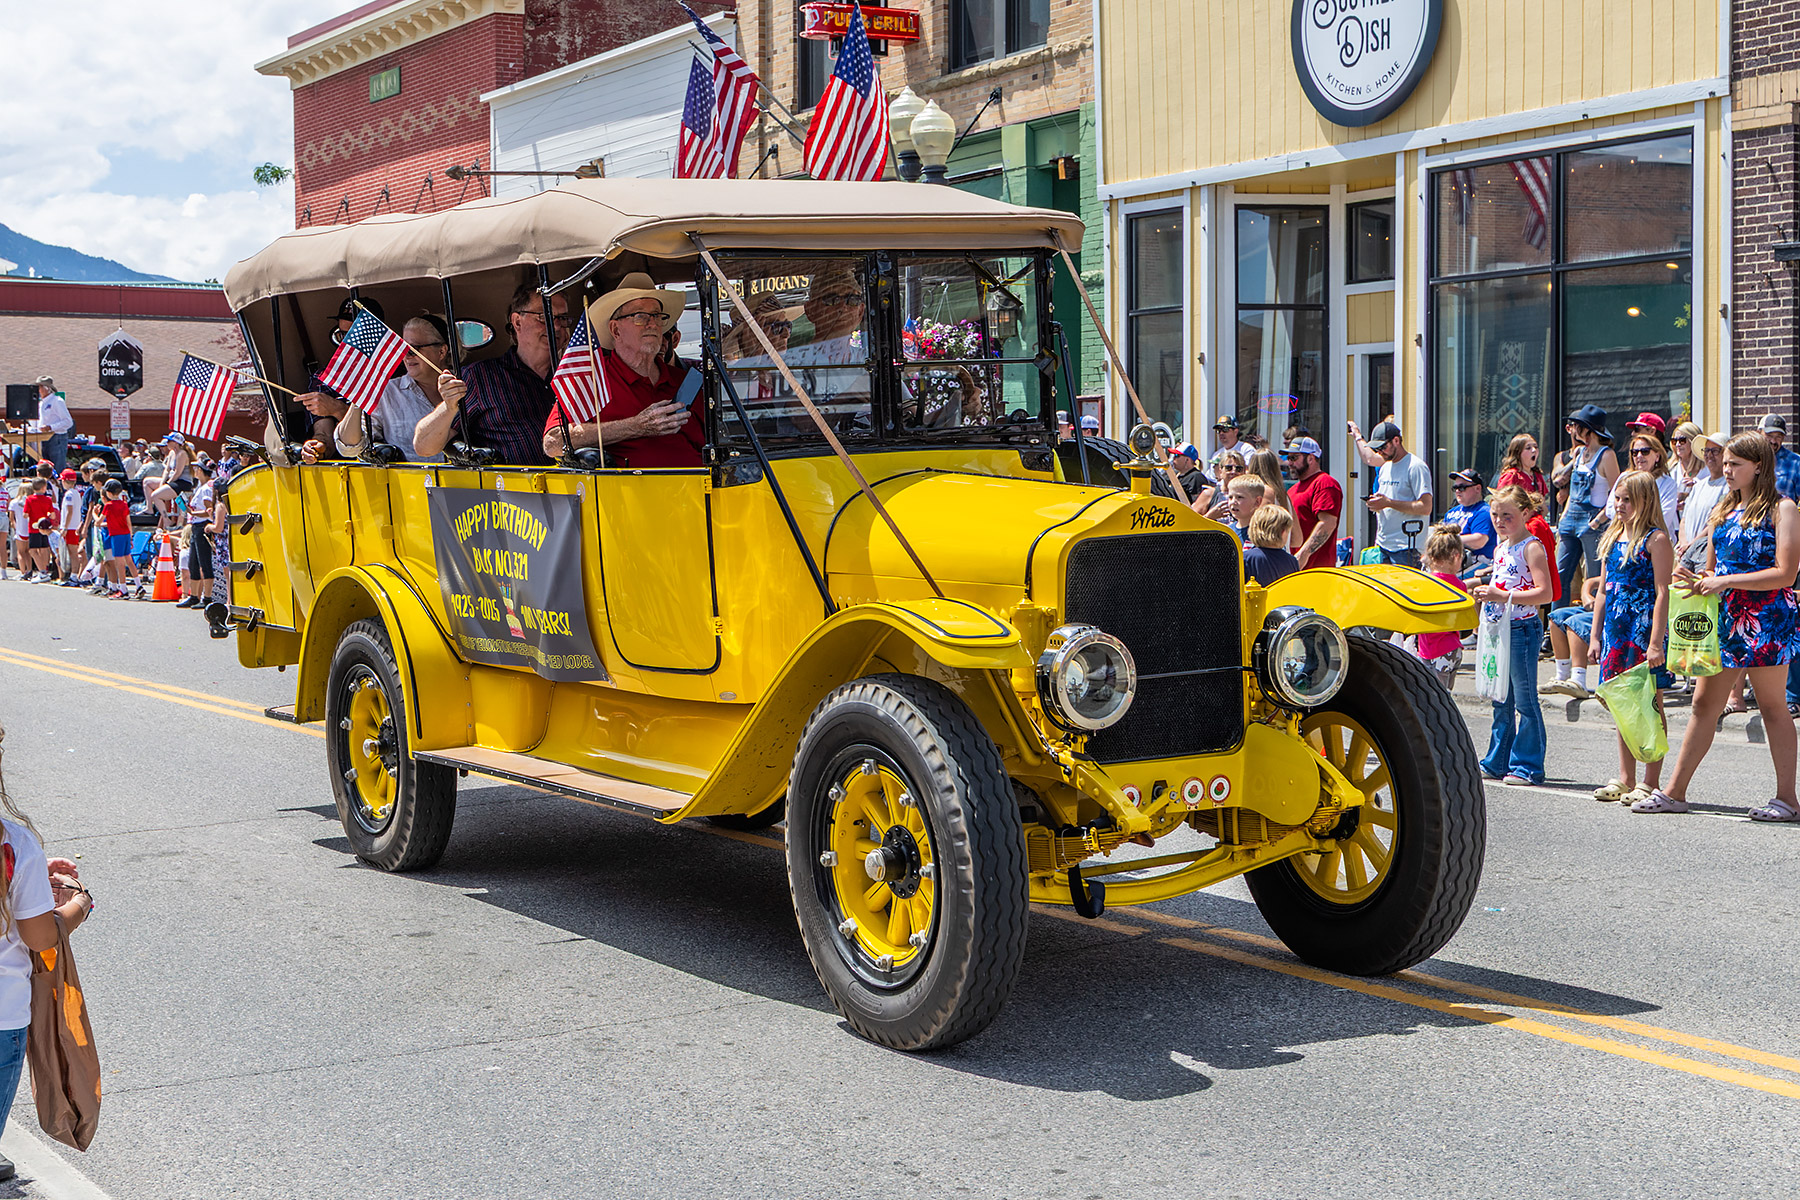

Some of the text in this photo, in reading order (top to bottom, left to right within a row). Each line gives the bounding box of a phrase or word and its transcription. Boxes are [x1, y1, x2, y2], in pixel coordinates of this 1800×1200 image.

[873, 15, 915, 32] GRILL
[1337, 15, 1390, 68] DISH
[1326, 61, 1401, 95] KITCHEN & HOME
[750, 280, 759, 295] &
[101, 359, 120, 367] Post
[101, 368, 125, 376] Office
[1257, 397, 1299, 409] OPEN
[454, 501, 548, 551] HAPPY BIRTHDAY
[1130, 505, 1176, 530] White
[472, 547, 493, 576] BUS
[532, 608, 573, 637] YEARS!
[563, 654, 595, 670] LODGE
